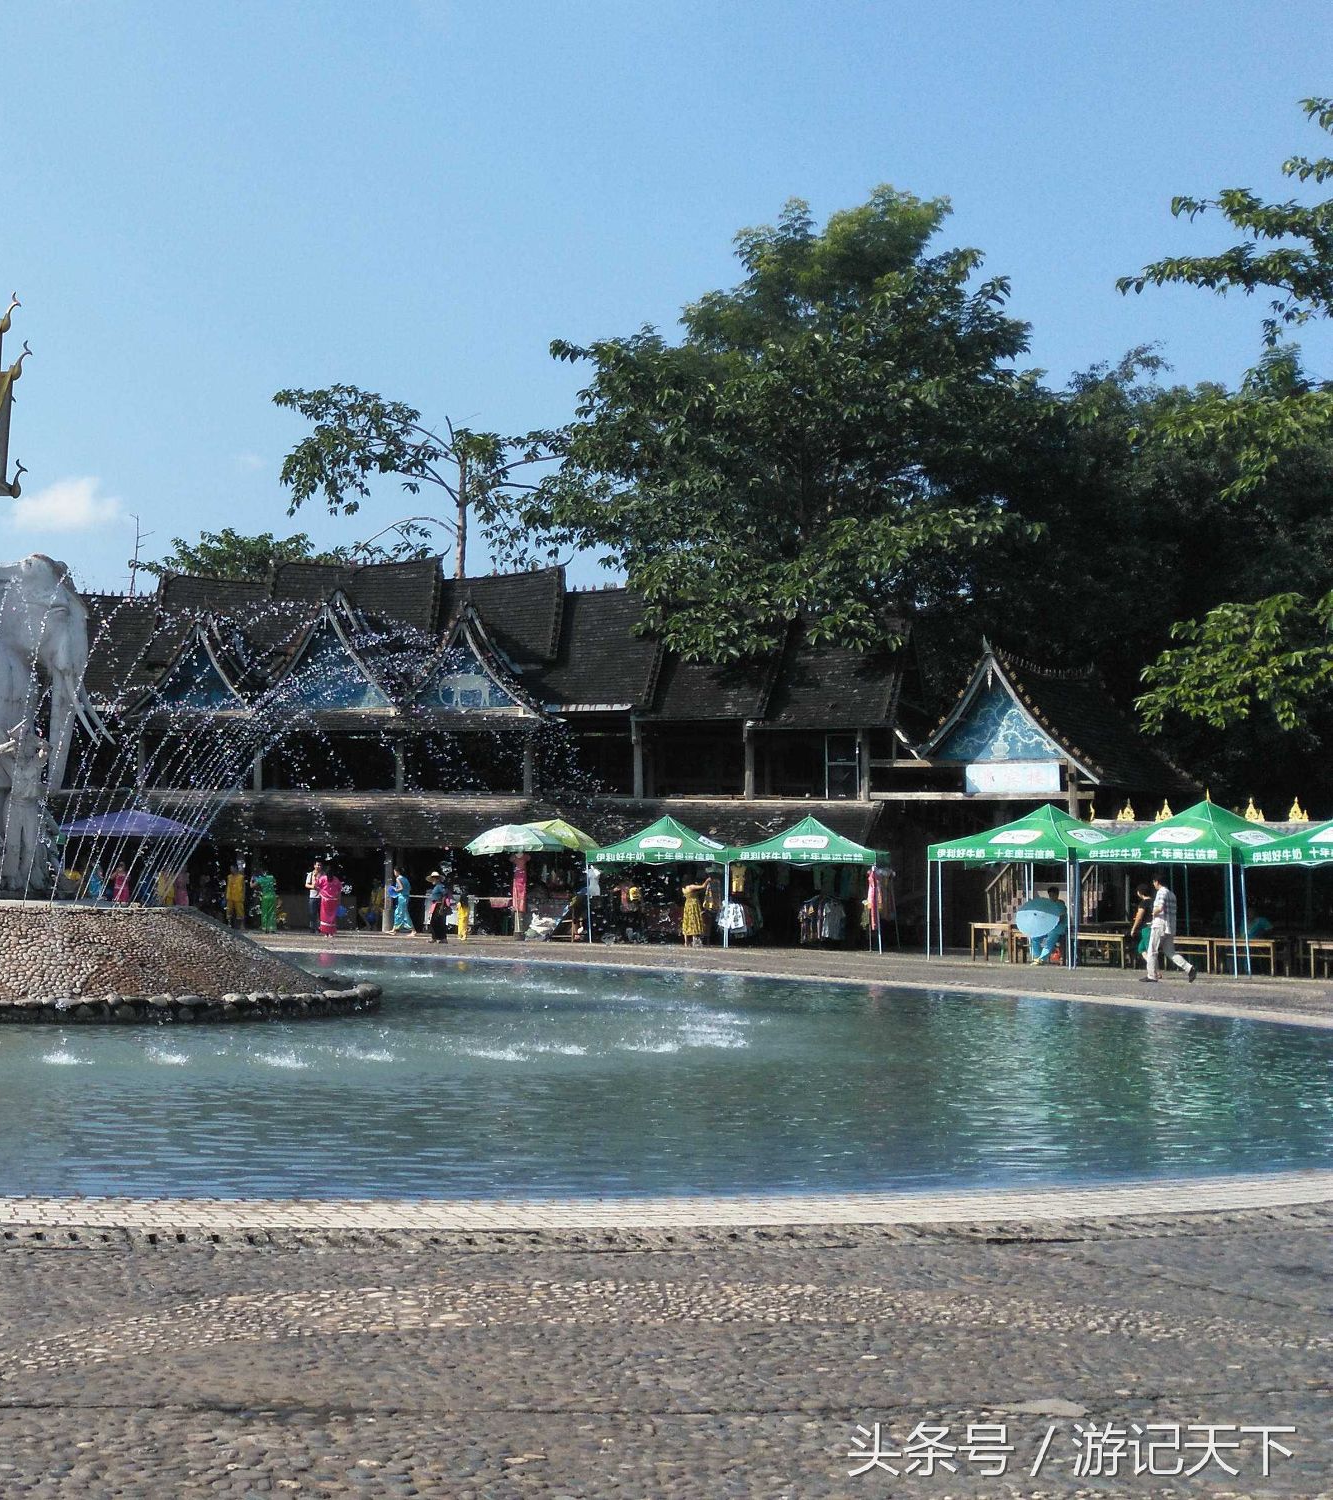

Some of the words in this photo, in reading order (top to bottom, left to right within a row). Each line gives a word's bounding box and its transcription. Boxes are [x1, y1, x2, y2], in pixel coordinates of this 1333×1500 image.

[596, 852, 645, 862] 伊利好牛奶
[740, 851, 792, 861] 伊利好牛奶
[936, 849, 985, 859] 伊利好牛奶
[1089, 848, 1141, 859] 伊利好牛奶
[1252, 848, 1302, 863] 伊利好牛奶
[1309, 847, 1333, 858] 十年
